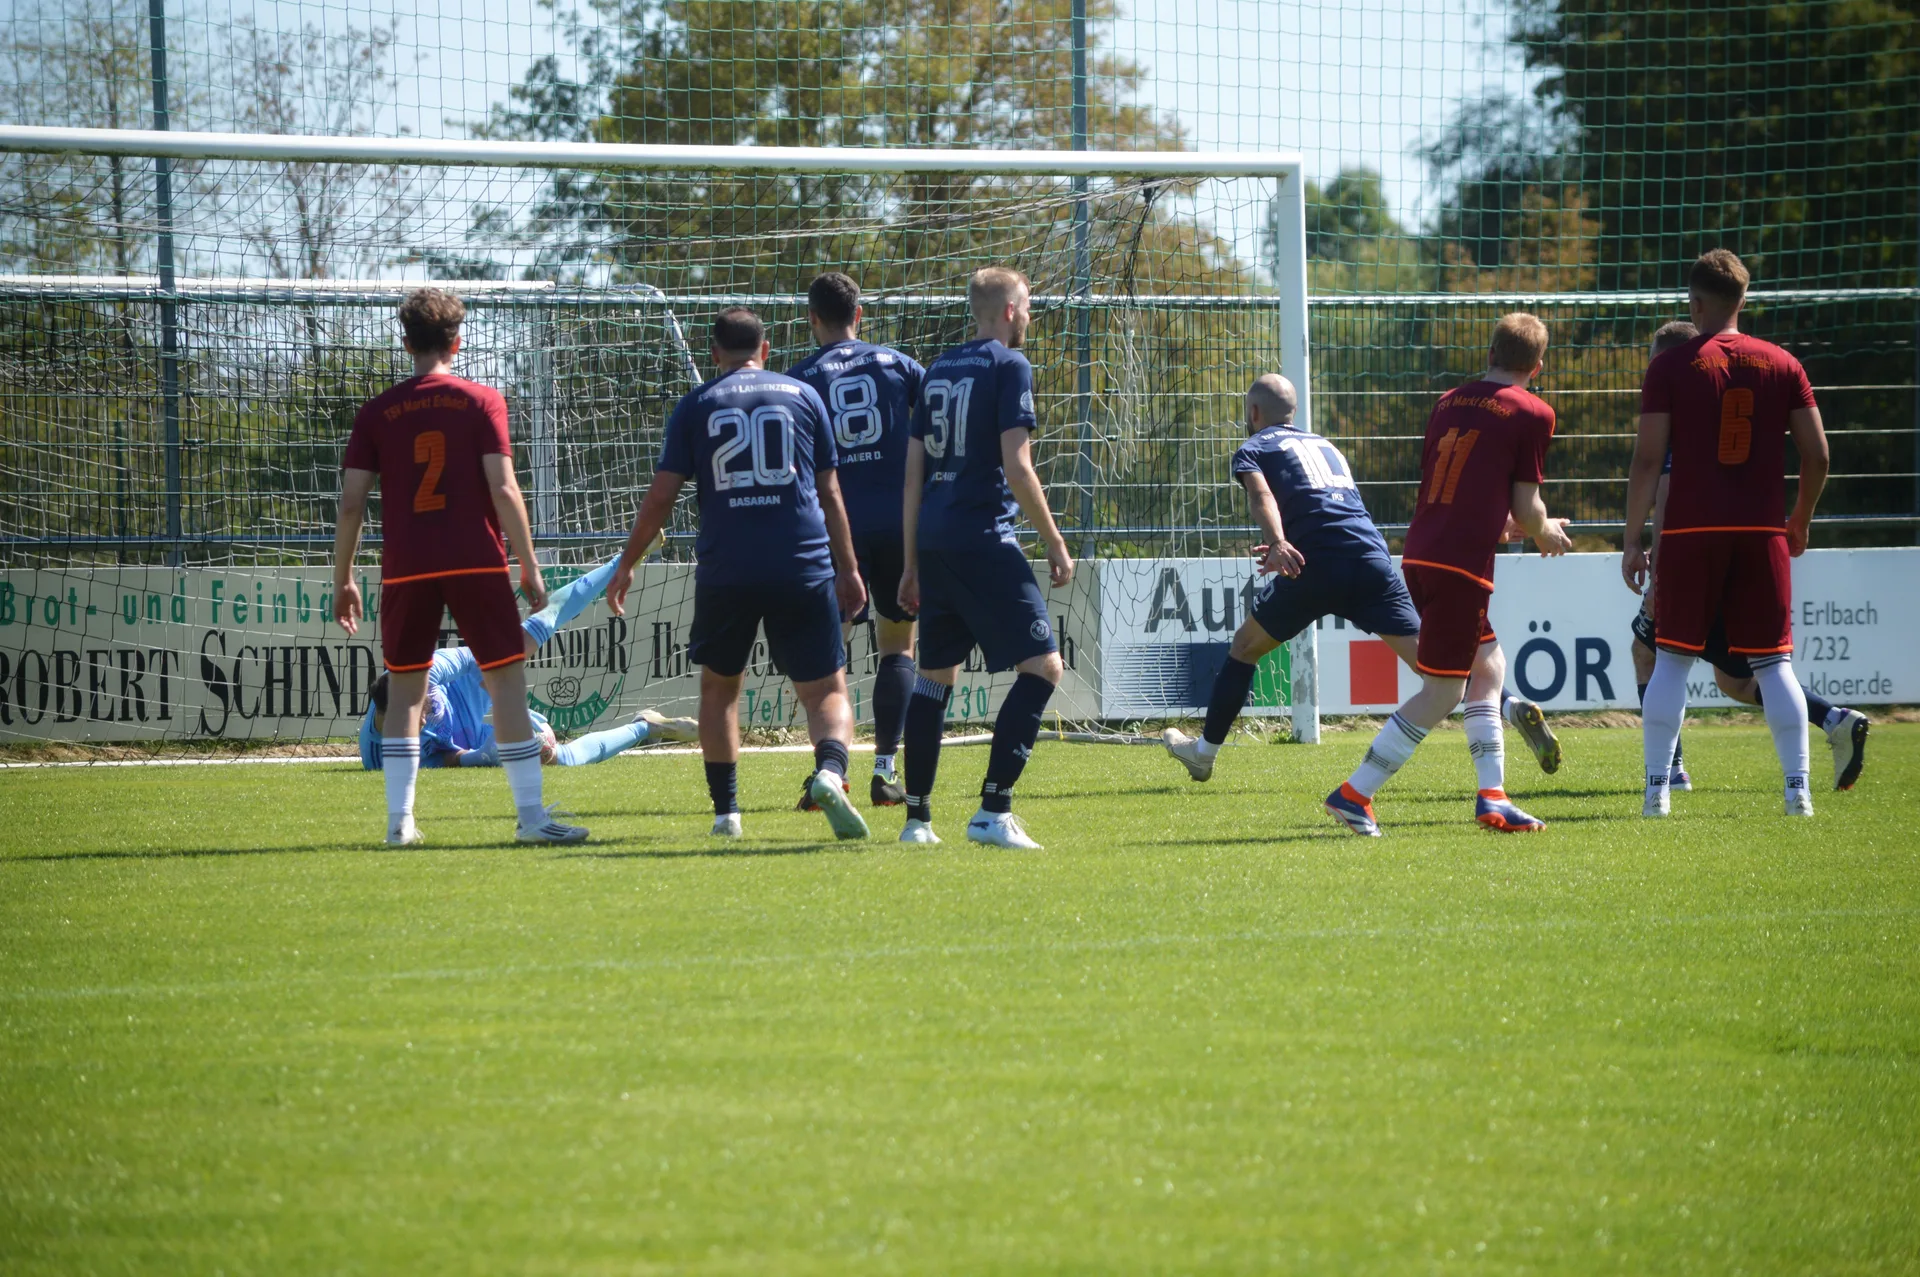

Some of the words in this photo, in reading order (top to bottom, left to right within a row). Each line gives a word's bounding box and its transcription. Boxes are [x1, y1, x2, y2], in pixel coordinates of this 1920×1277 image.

[707, 404, 798, 492] 20
[829, 374, 883, 449] 8
[923, 376, 975, 459] 31
[1718, 387, 1755, 466] 6
[413, 429, 447, 514] 2
[729, 494, 781, 508] BASARAN
[1277, 436, 1355, 490] 10
[1426, 426, 1482, 505] 11
[123, 576, 187, 626] und
[211, 576, 377, 625] Feinbäk
[1802, 599, 1879, 627] Erlbach
[1513, 619, 1617, 703] ÖR
